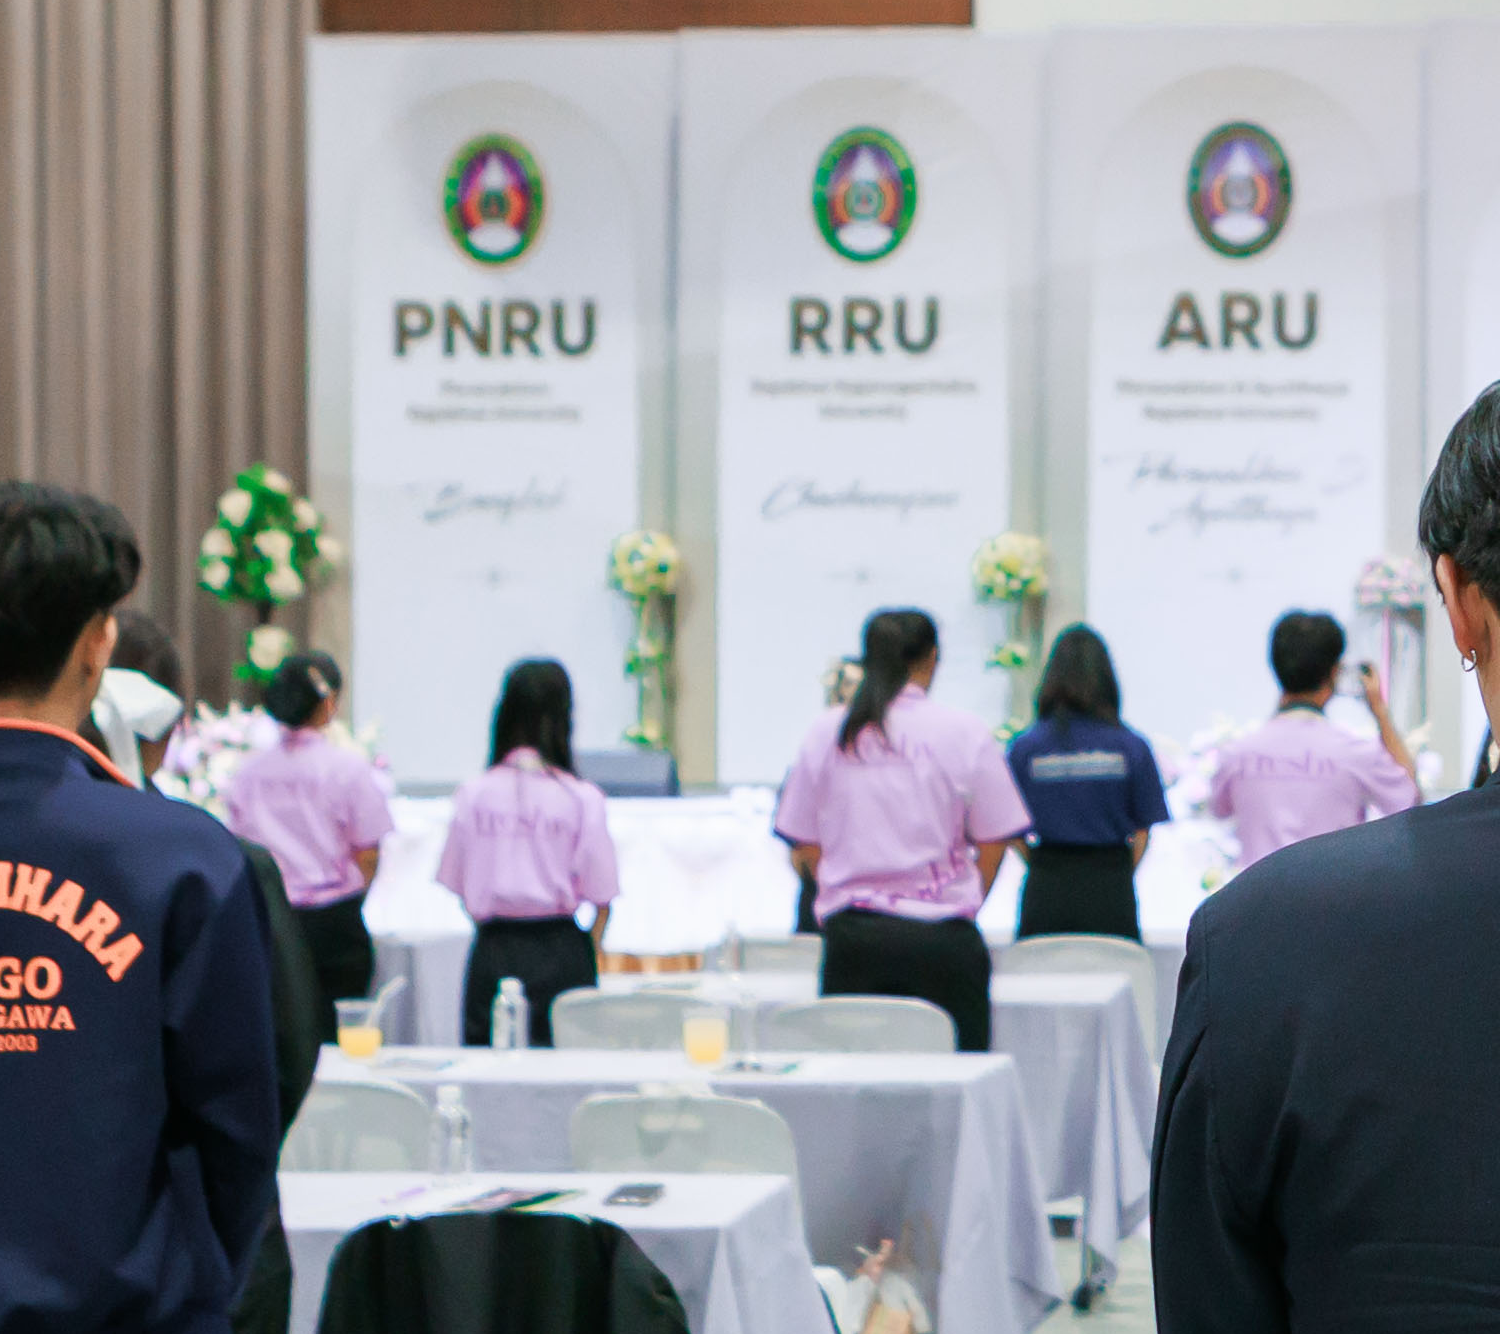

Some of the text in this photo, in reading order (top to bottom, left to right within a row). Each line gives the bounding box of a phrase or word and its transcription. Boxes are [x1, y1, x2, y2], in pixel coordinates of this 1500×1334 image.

[393, 299, 596, 357] PNRU
[789, 295, 940, 355] RRU
[1156, 289, 1319, 351] ARU
